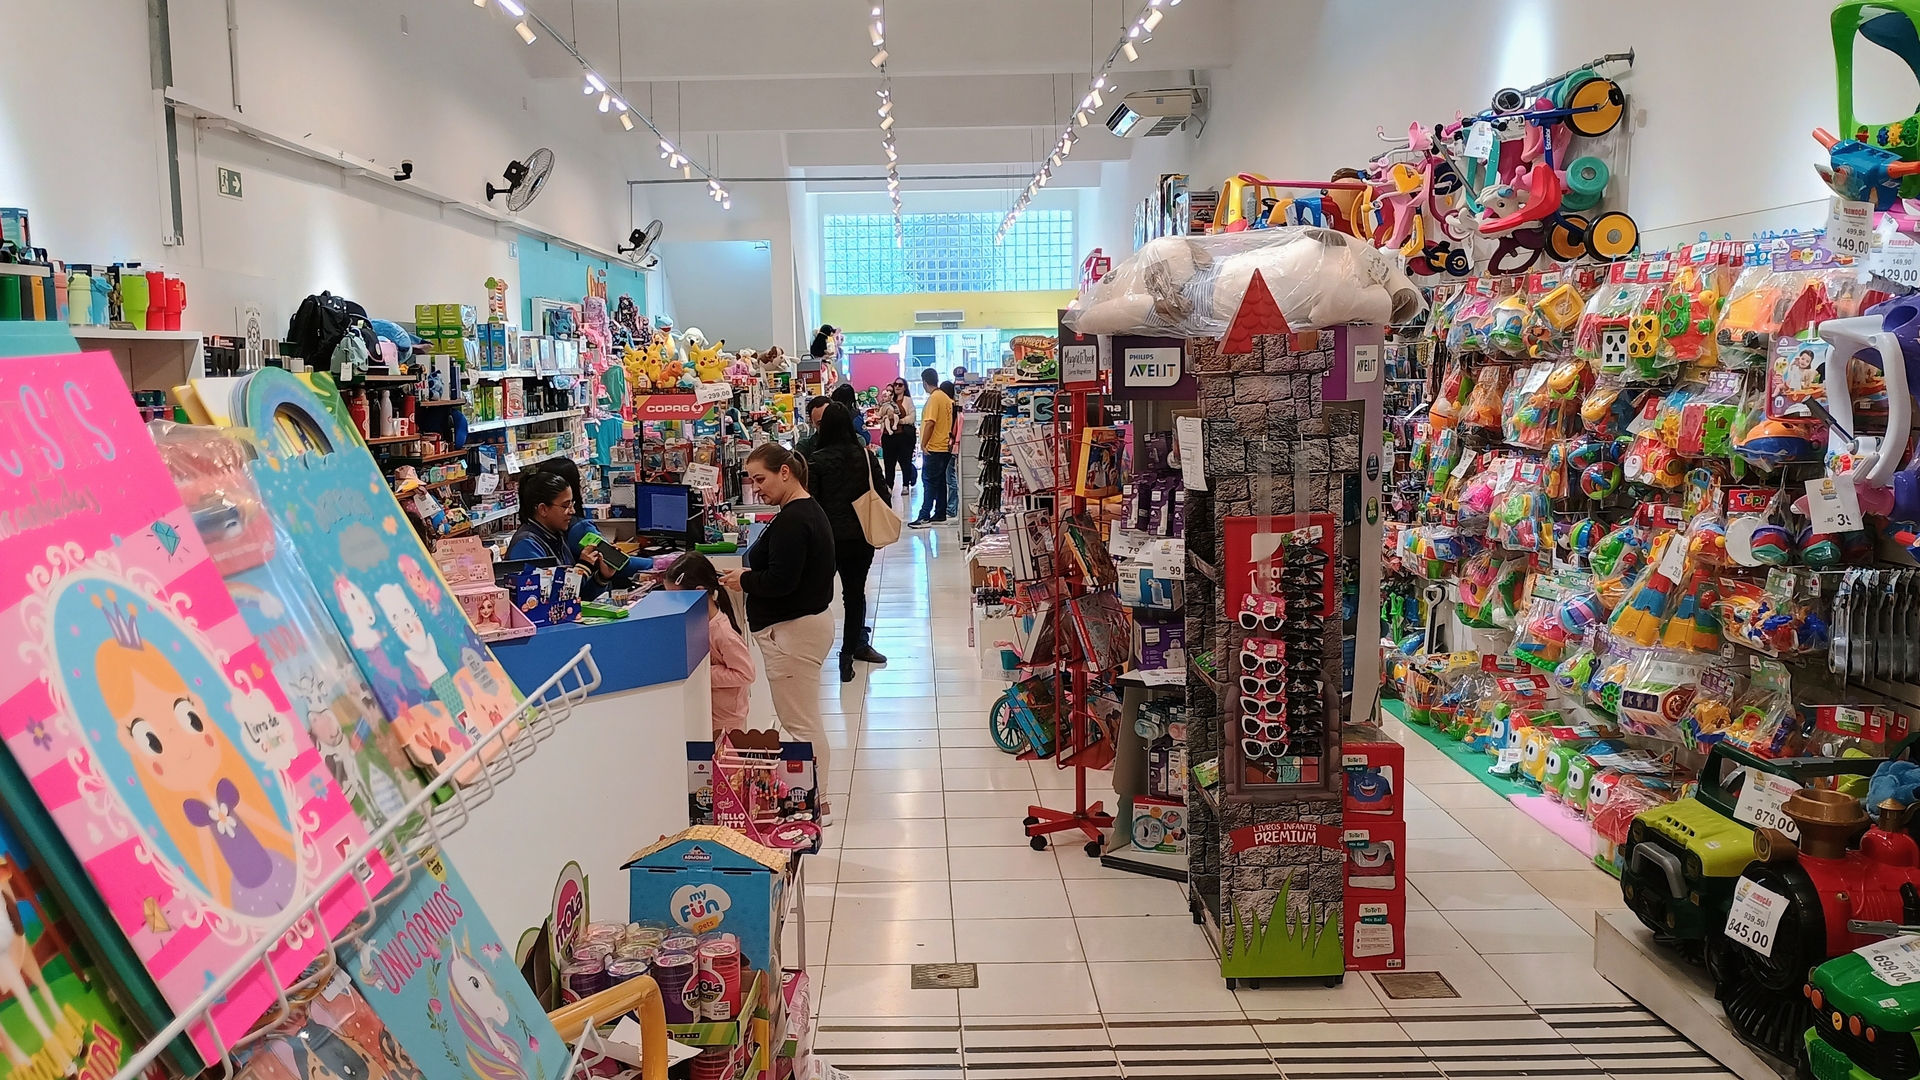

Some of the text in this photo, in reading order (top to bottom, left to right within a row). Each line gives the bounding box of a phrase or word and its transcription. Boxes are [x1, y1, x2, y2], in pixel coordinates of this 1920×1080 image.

[1843, 207, 1867, 216] PROMOÇÃO
[1846, 227, 1866, 236] 499,90
[1836, 236, 1868, 254] 449,00
[1888, 239, 1915, 247] PROMOÇÃO
[1881, 269, 1918, 282] 129,00
[708, 390, 730, 399] 299,00
[1754, 808, 1796, 833] 879,00
[1253, 823, 1316, 833] LIVROS INFANTIS
[1254, 831, 1316, 844] PREMIUM
[689, 890, 706, 903] my
[1751, 892, 1773, 908] PROMOÇÃO
[698, 920, 714, 931] pets
[1743, 911, 1765, 928] 939,50
[372, 884, 464, 994] UNICÓRNIOS
[1728, 918, 1769, 948] 845,00
[1873, 955, 1912, 982] 699,00
